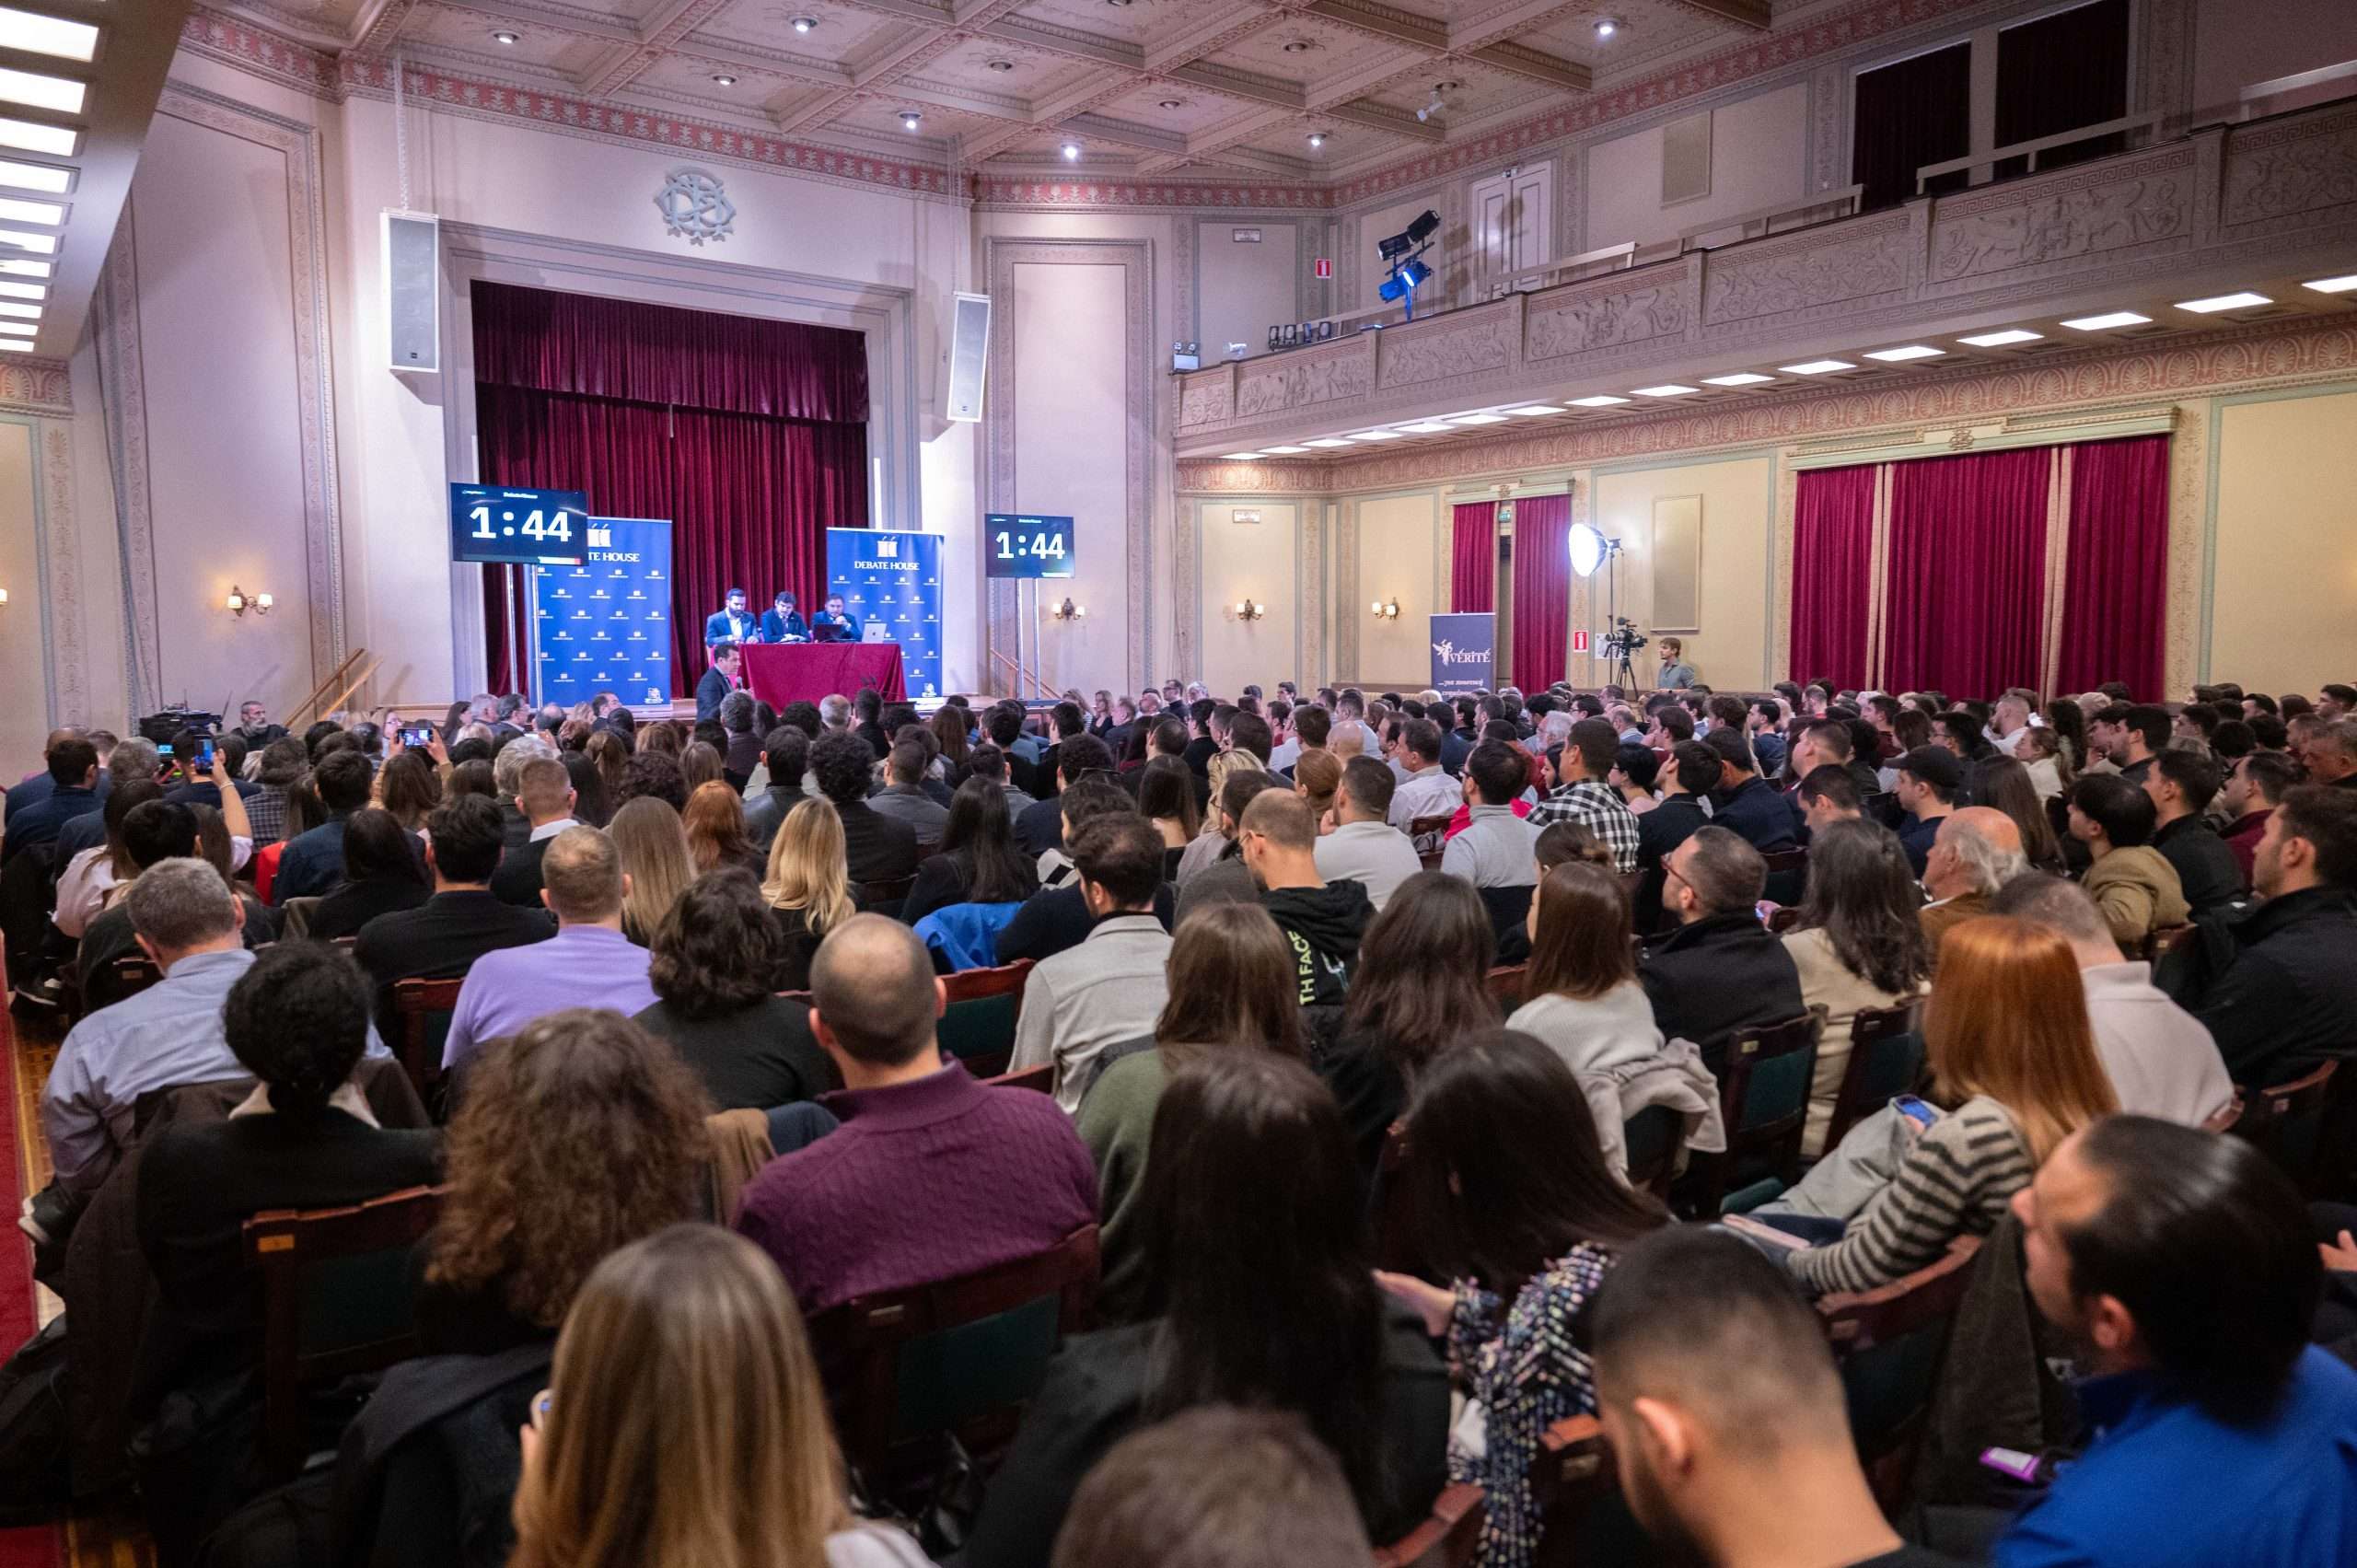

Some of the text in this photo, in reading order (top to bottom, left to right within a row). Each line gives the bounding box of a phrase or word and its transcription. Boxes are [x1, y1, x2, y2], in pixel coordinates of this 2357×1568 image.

[469, 506, 573, 542] 1:44
[995, 531, 1066, 560] 1:44
[602, 552, 641, 563] HOUSE
[853, 560, 920, 571] DEBATE HOUSE
